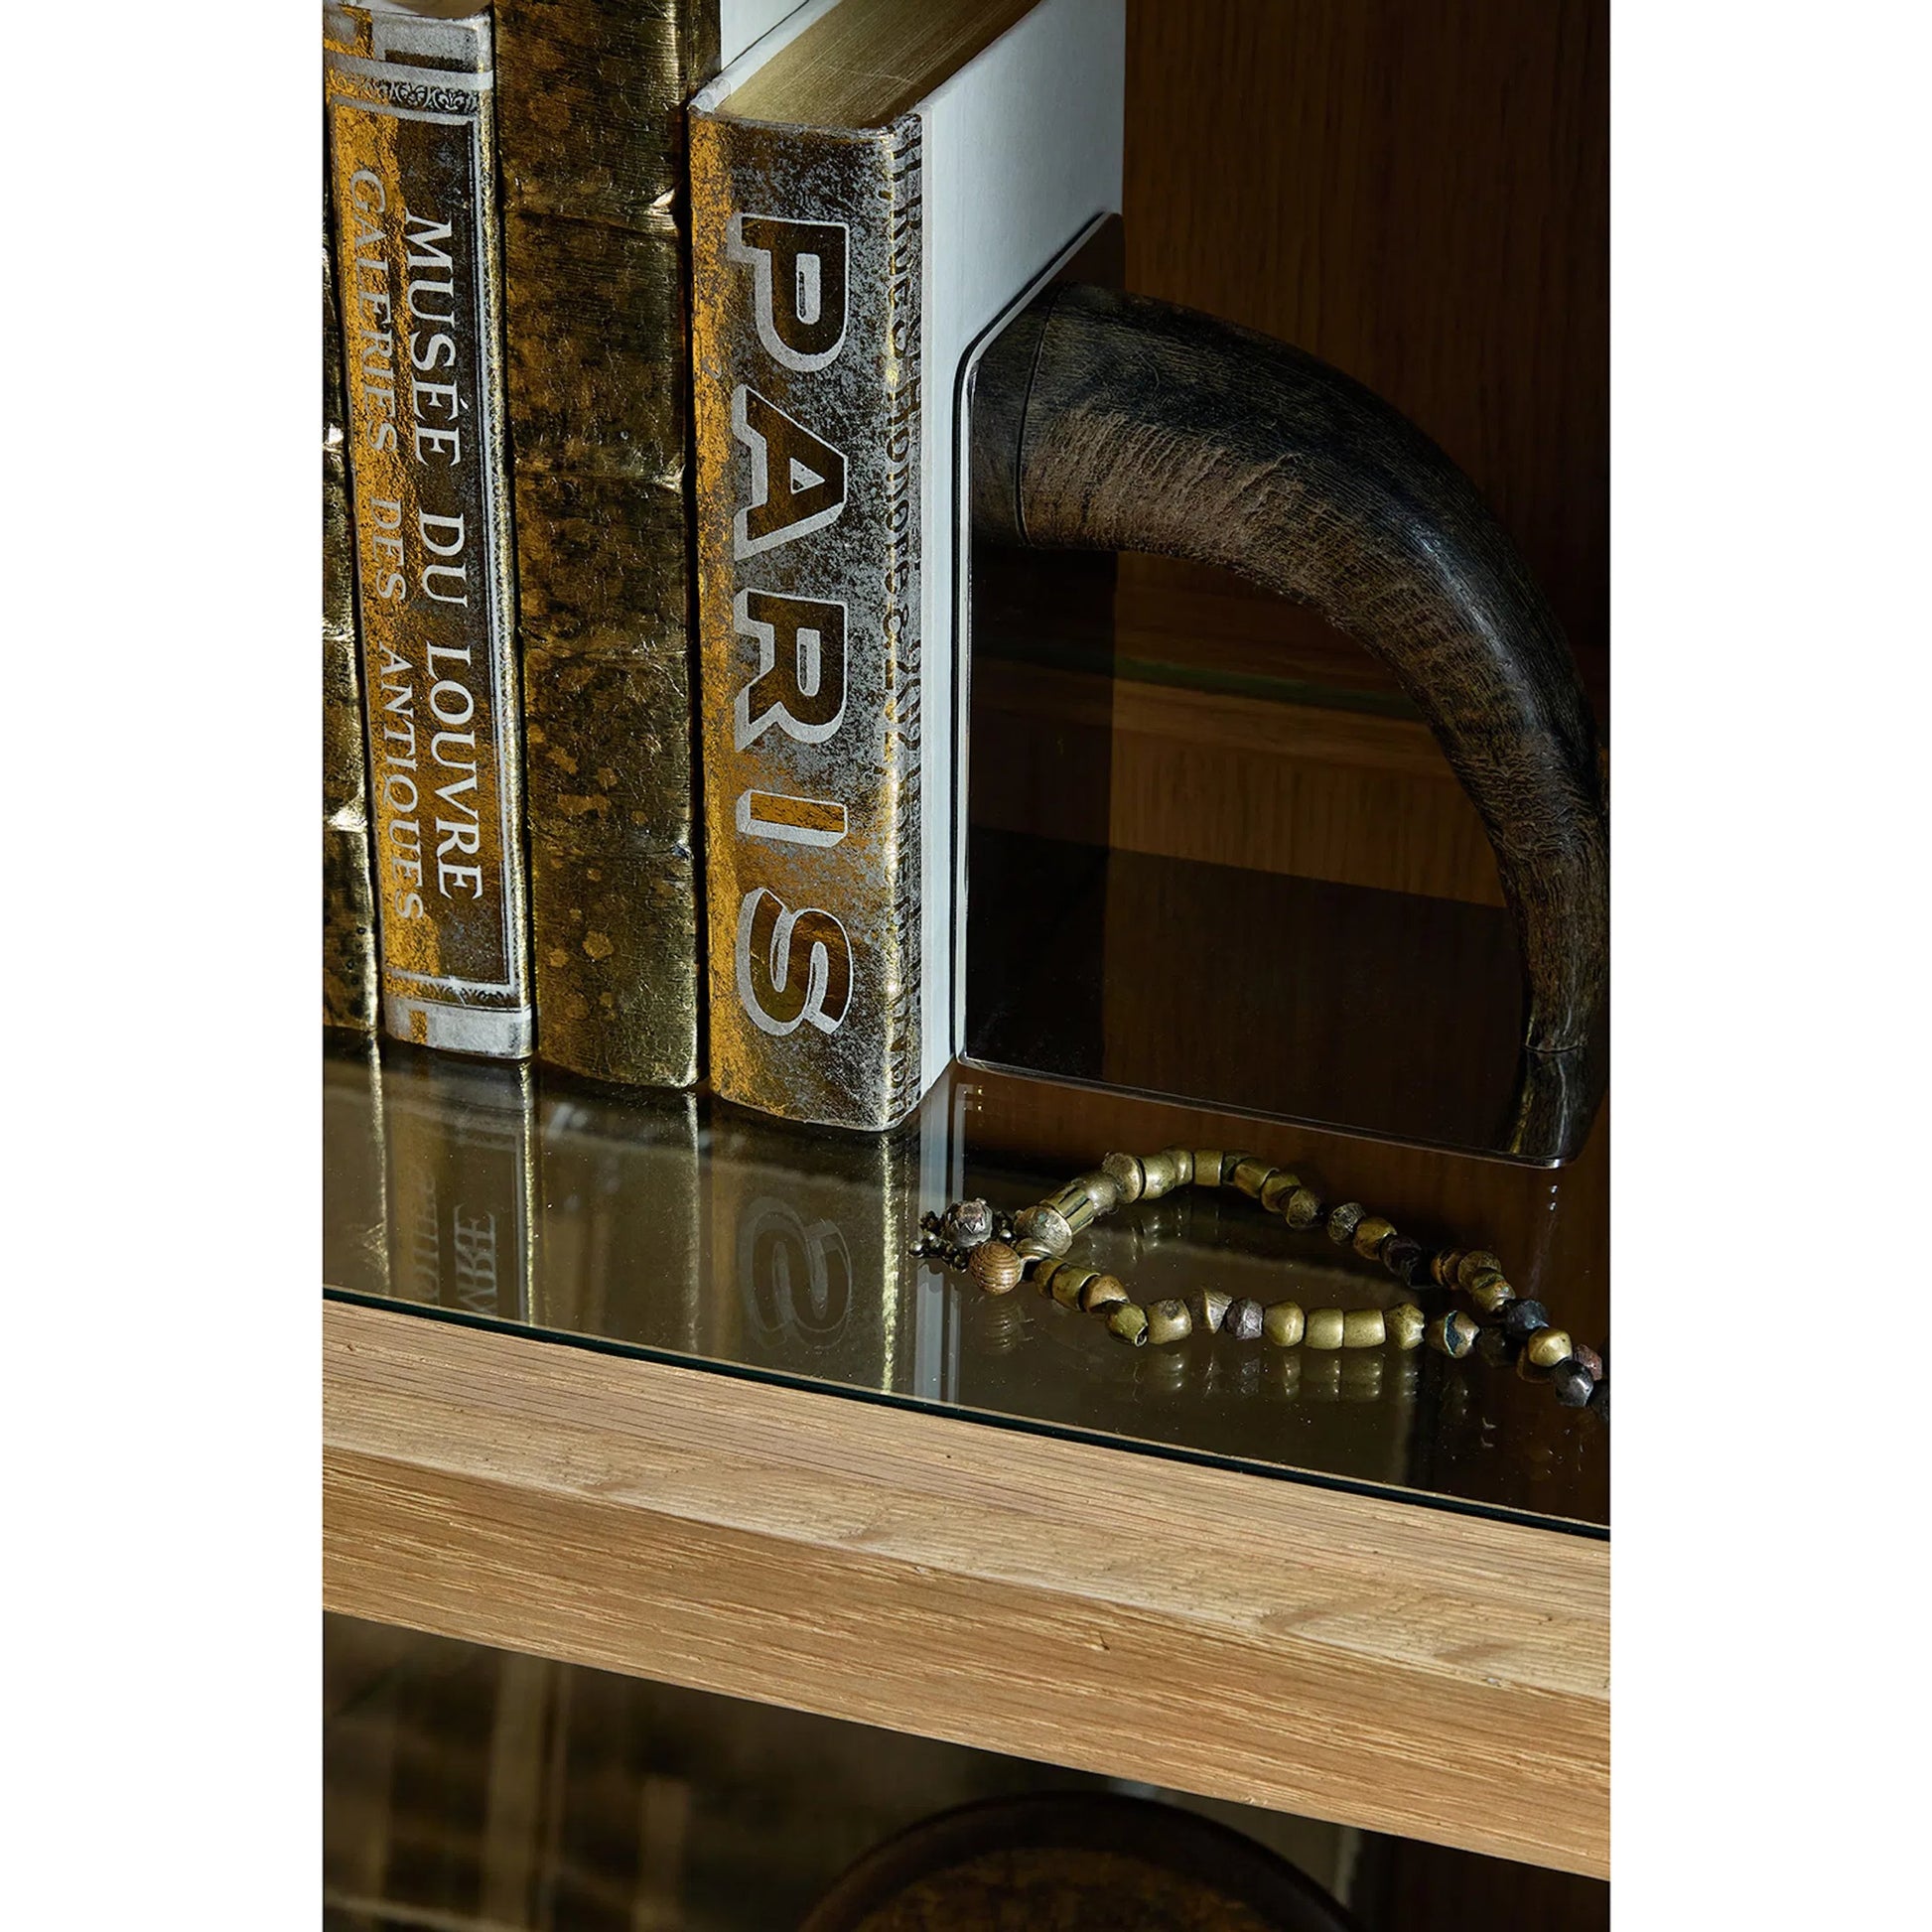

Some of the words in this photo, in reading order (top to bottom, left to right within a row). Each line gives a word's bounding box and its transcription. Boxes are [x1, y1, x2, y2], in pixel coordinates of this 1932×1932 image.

[349, 169, 398, 454] GALERIES
[404, 209, 469, 467] MUSÉE
[368, 496, 407, 602] DES
[418, 507, 469, 609] DU
[727, 213, 854, 1036] PARIS
[378, 641, 425, 920] ANTIQUES
[425, 640, 483, 900] LOUVRE
